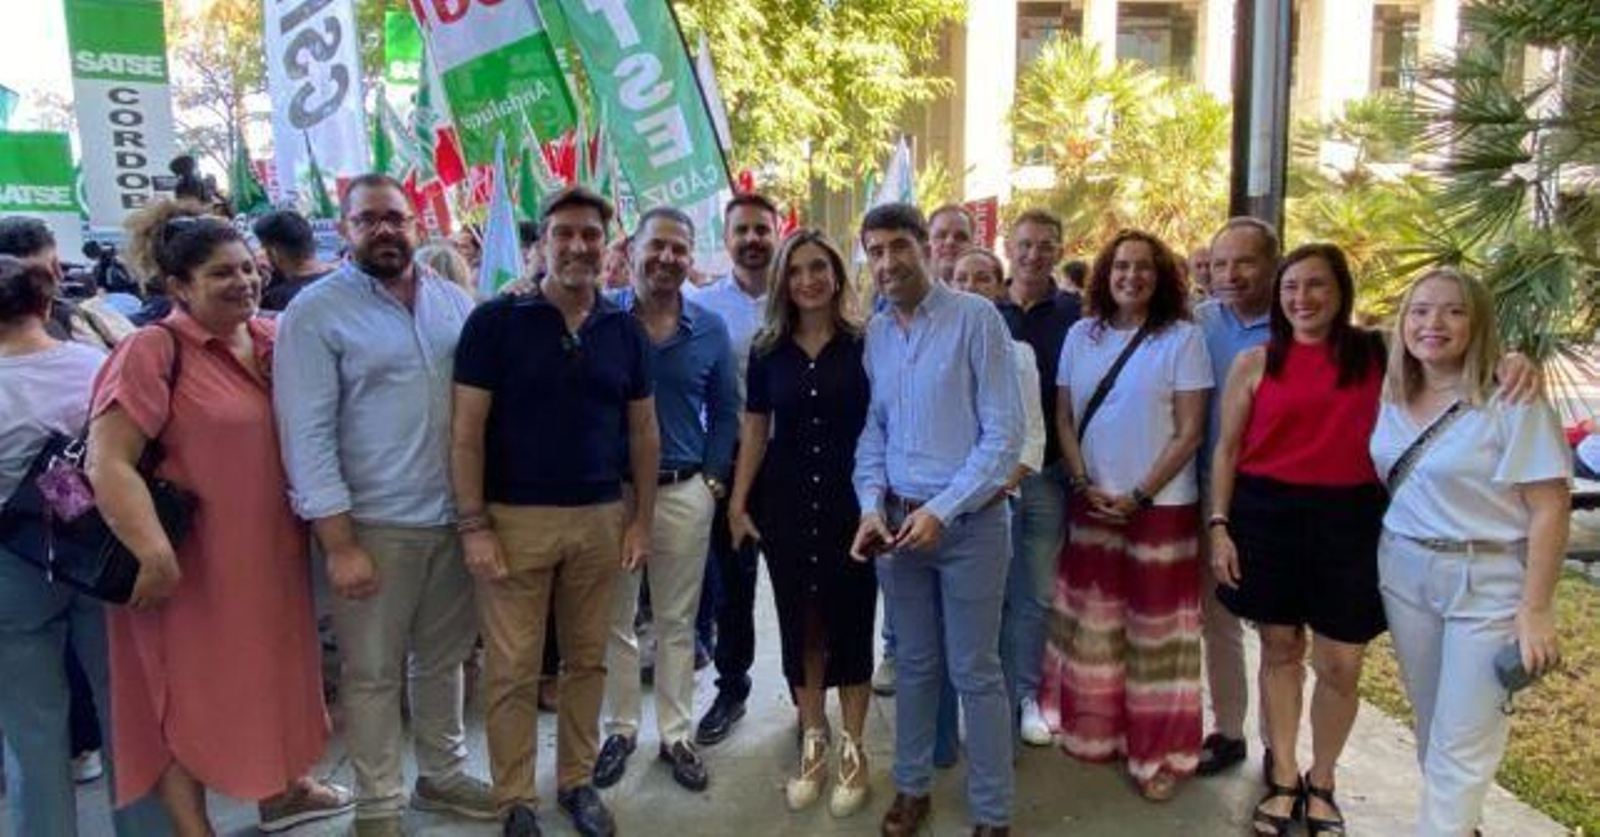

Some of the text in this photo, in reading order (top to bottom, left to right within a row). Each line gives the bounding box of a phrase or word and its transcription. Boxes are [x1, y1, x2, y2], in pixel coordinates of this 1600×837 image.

[76, 51, 164, 77] SATSE
[108, 87, 150, 209] CORDOB
[0, 184, 72, 204] ATSE
